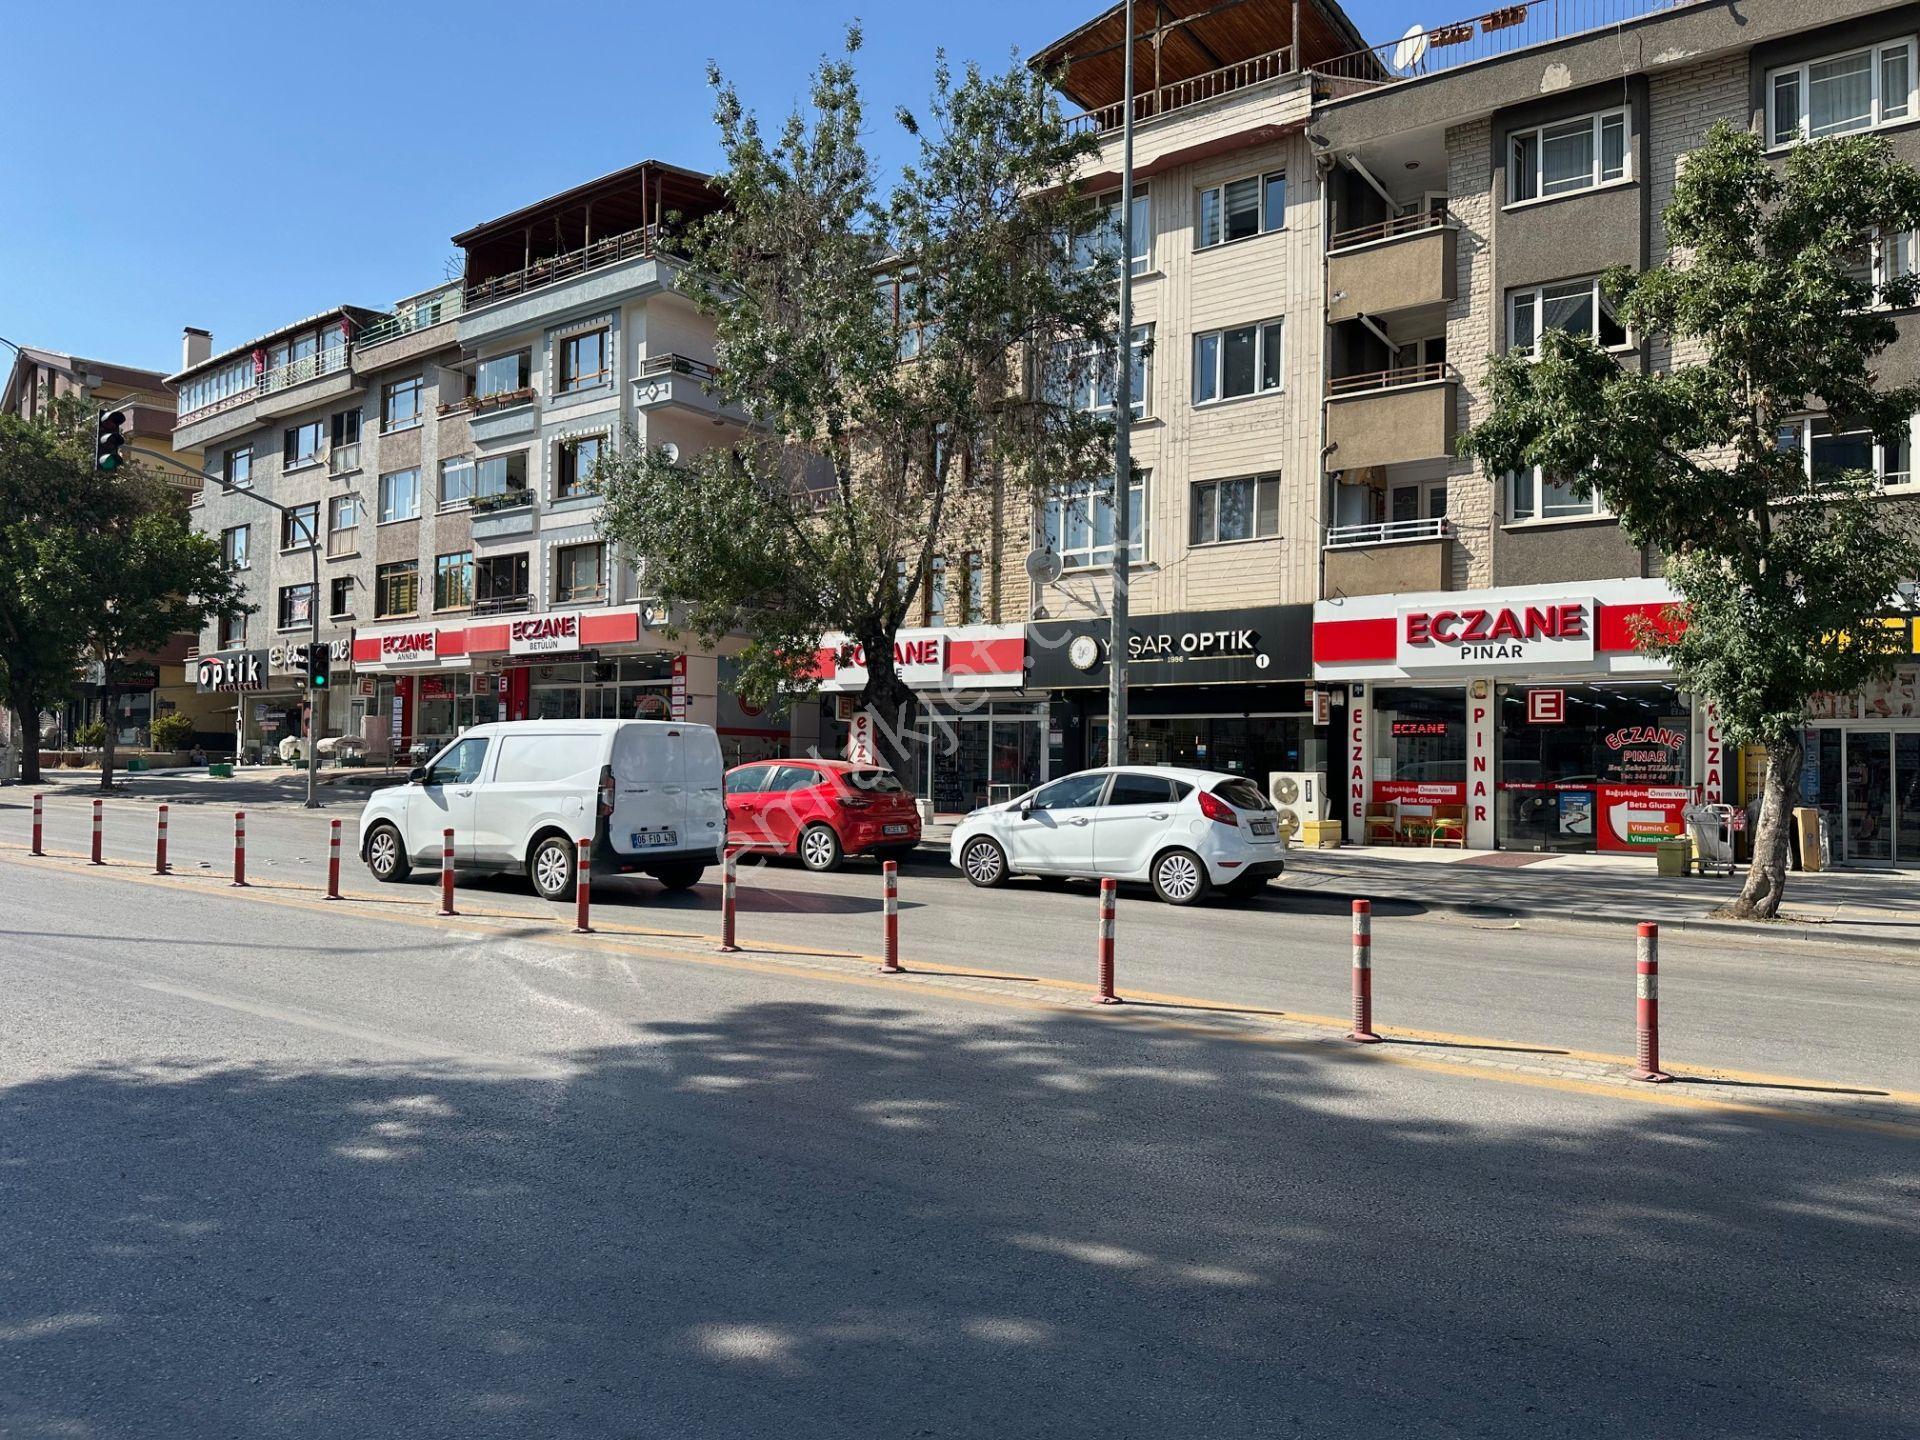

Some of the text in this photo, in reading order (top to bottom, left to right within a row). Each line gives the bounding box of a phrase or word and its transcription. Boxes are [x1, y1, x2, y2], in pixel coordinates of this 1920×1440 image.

[512, 616, 577, 641] ECZANE
[1406, 604, 1583, 643] ECZANE
[383, 632, 434, 654] ECZANE
[530, 639, 558, 651] BETÜLÜN
[1102, 634, 1172, 659] YŞAR
[1460, 645, 1523, 659] PINAR
[397, 652, 418, 661] ANNEM
[200, 654, 260, 692] optik
[500, 678, 507, 690] E
[1535, 694, 1557, 718] E
[1392, 723, 1446, 734] ECZANE
[1605, 726, 1687, 750] ECZANE
[1352, 708, 1363, 818] ECZANE
[1474, 708, 1486, 822] PINAR
[1623, 750, 1667, 762] PINAR
[1650, 789, 1672, 797] Önem
[1629, 801, 1676, 809] Beta Glucan
[1631, 824, 1661, 832] Vitamin
